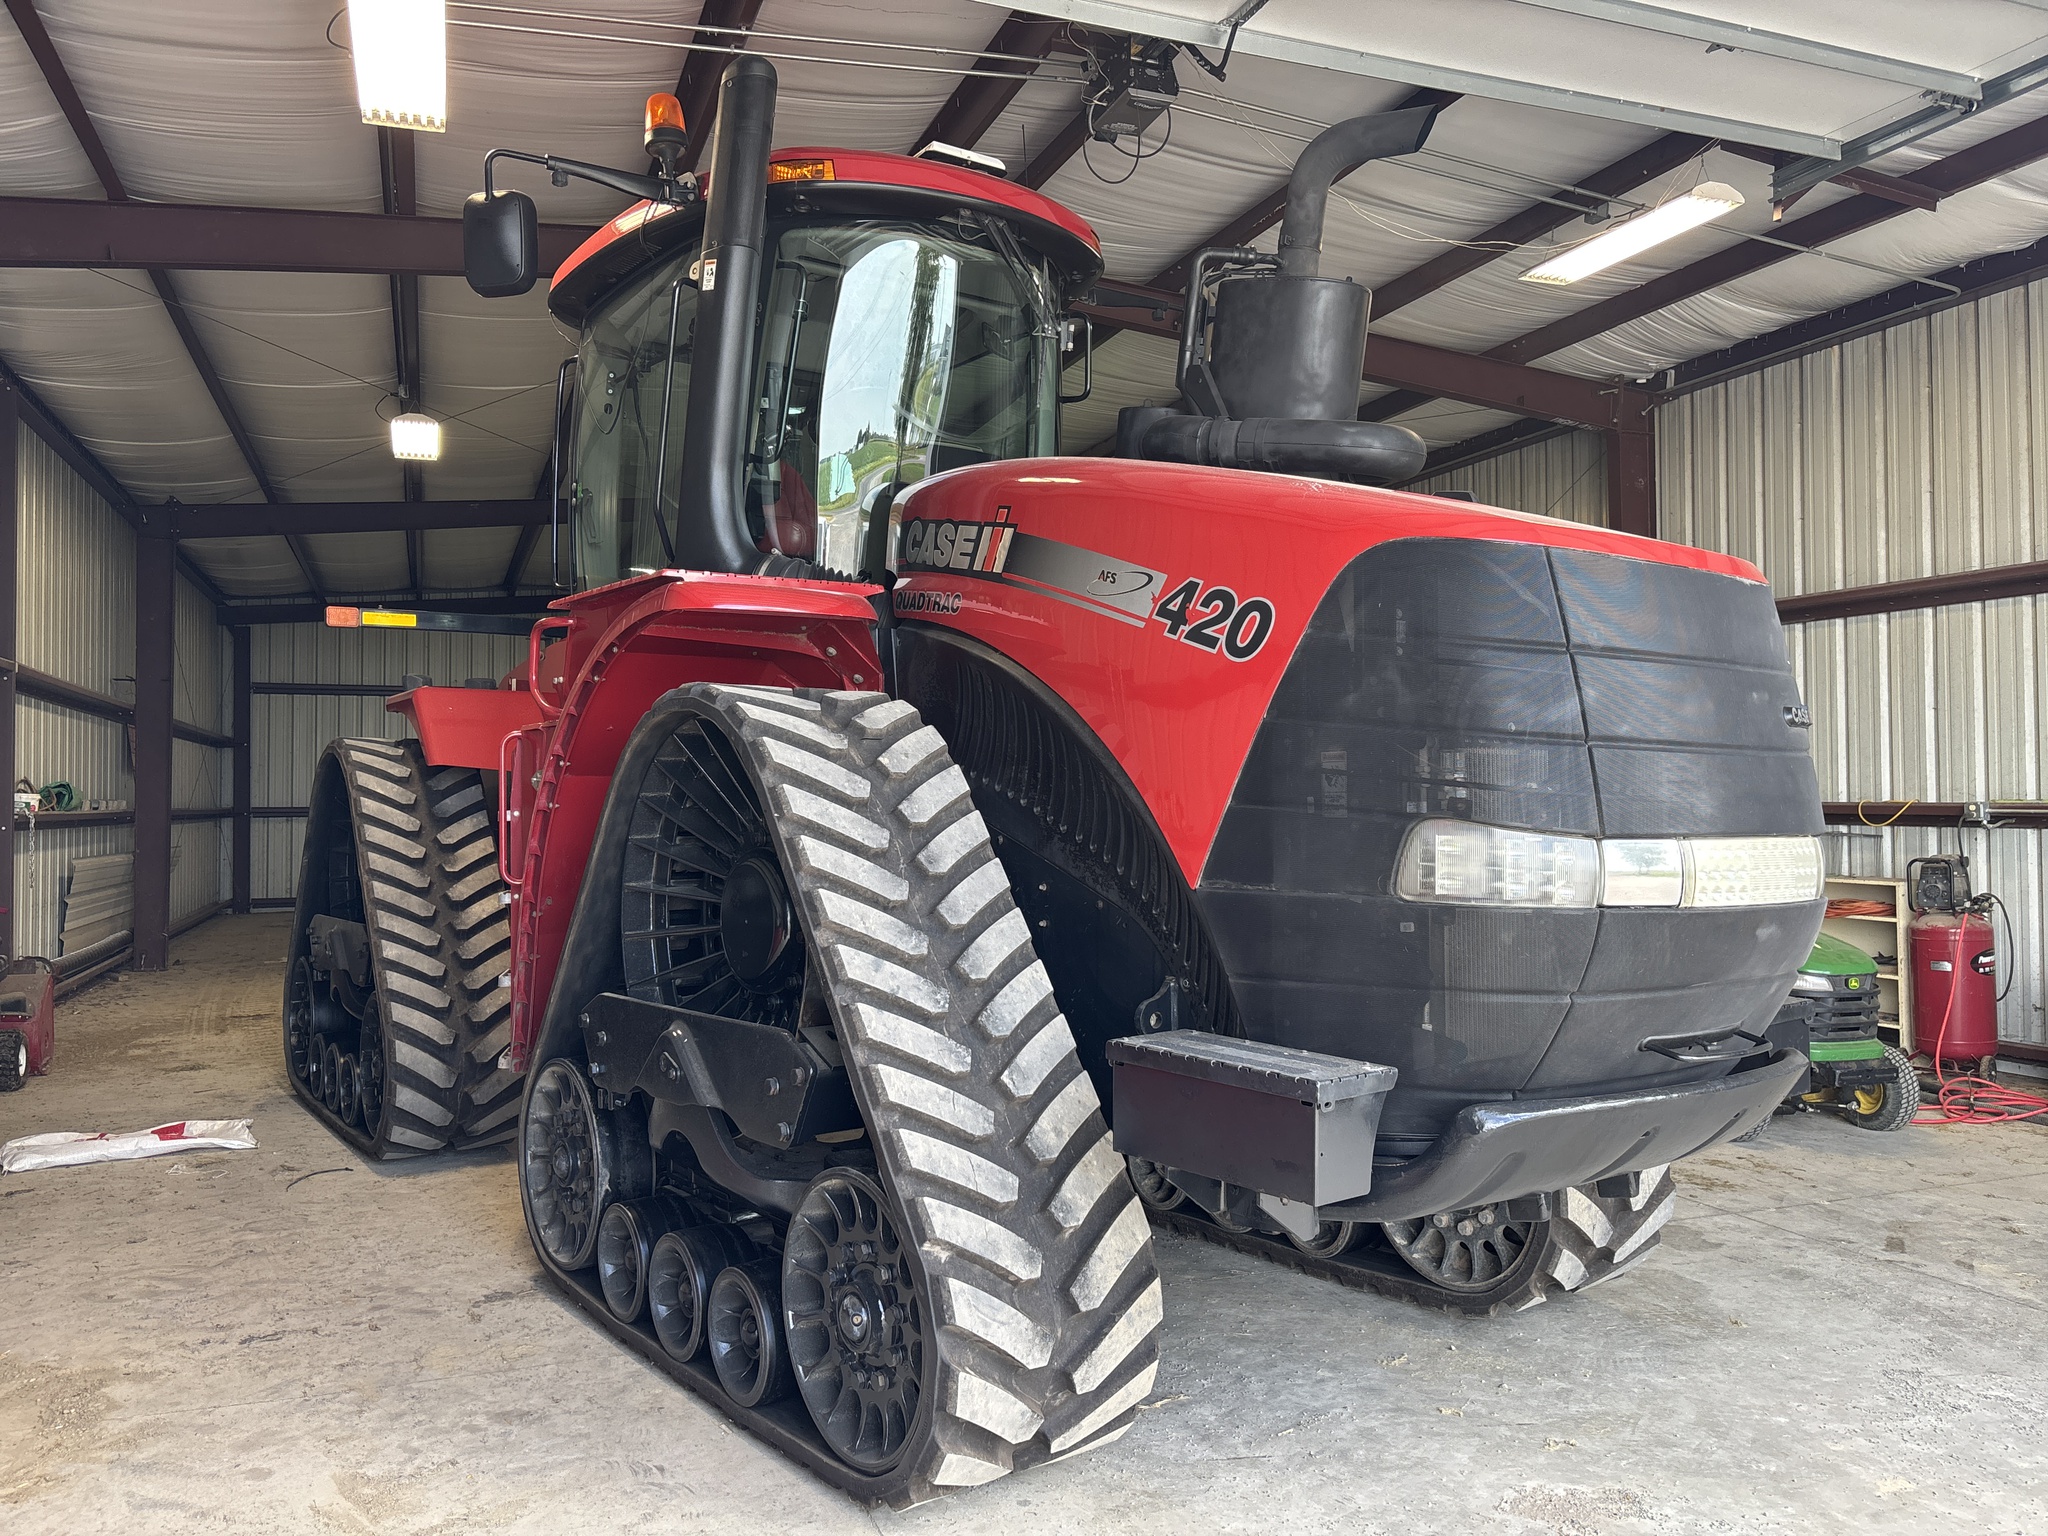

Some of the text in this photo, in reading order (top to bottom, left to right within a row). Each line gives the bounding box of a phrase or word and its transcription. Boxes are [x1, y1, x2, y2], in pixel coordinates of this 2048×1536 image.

[905, 520, 979, 569] CASE
[1098, 569, 1117, 585] AFS
[895, 590, 962, 615] QUADTRAC
[1151, 577, 1275, 662] 420
